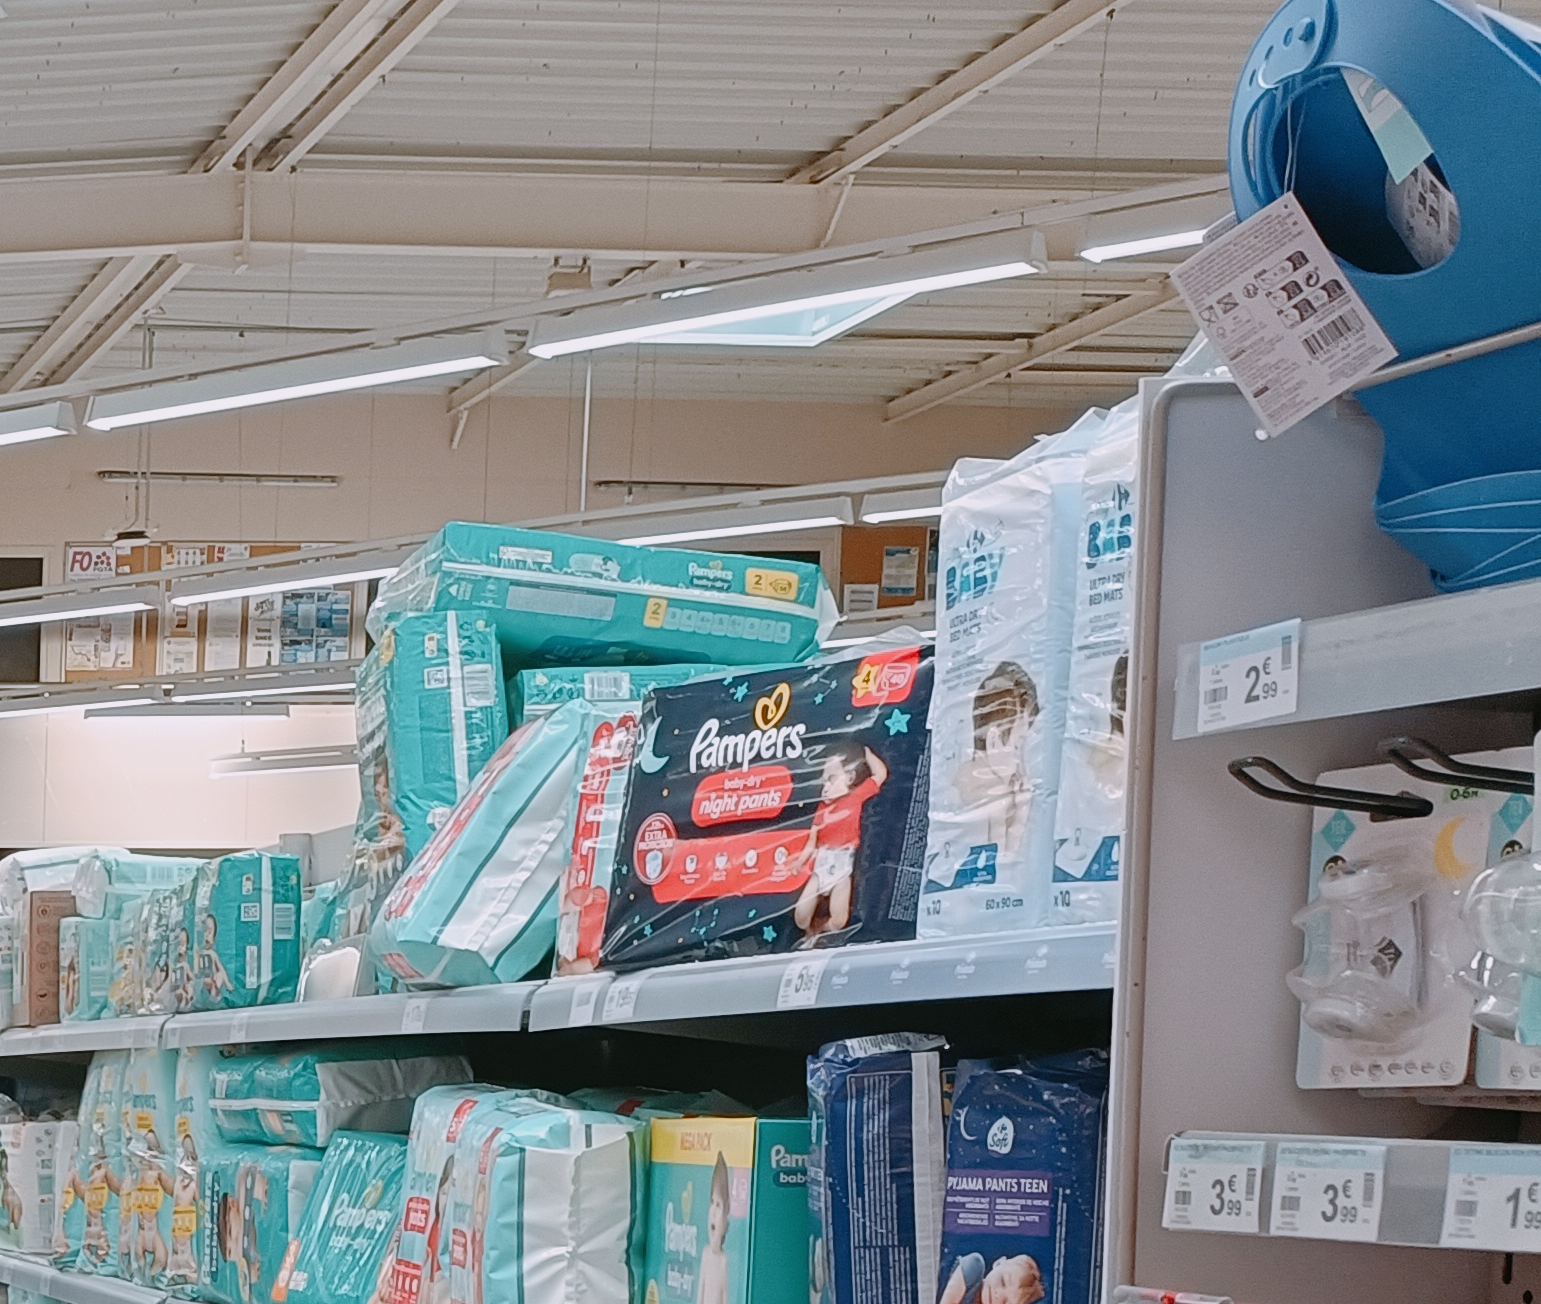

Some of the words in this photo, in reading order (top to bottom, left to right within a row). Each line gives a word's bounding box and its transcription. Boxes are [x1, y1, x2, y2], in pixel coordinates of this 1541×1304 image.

[70, 550, 92, 572] FO
[688, 562, 733, 582] Pampers
[753, 574, 763, 586] 2
[1089, 593, 1103, 607] BED
[1103, 588, 1123, 604] MATS
[651, 602, 662, 616] 2
[690, 718, 806, 774] Pampers
[700, 794, 735, 819] night
[738, 789, 782, 814] pants
[989, 1131, 1010, 1149] Soft
[947, 1176, 983, 1191] PYJAMA
[985, 1178, 1018, 1192] PANTS
[1019, 1178, 1048, 1193] TEEN
